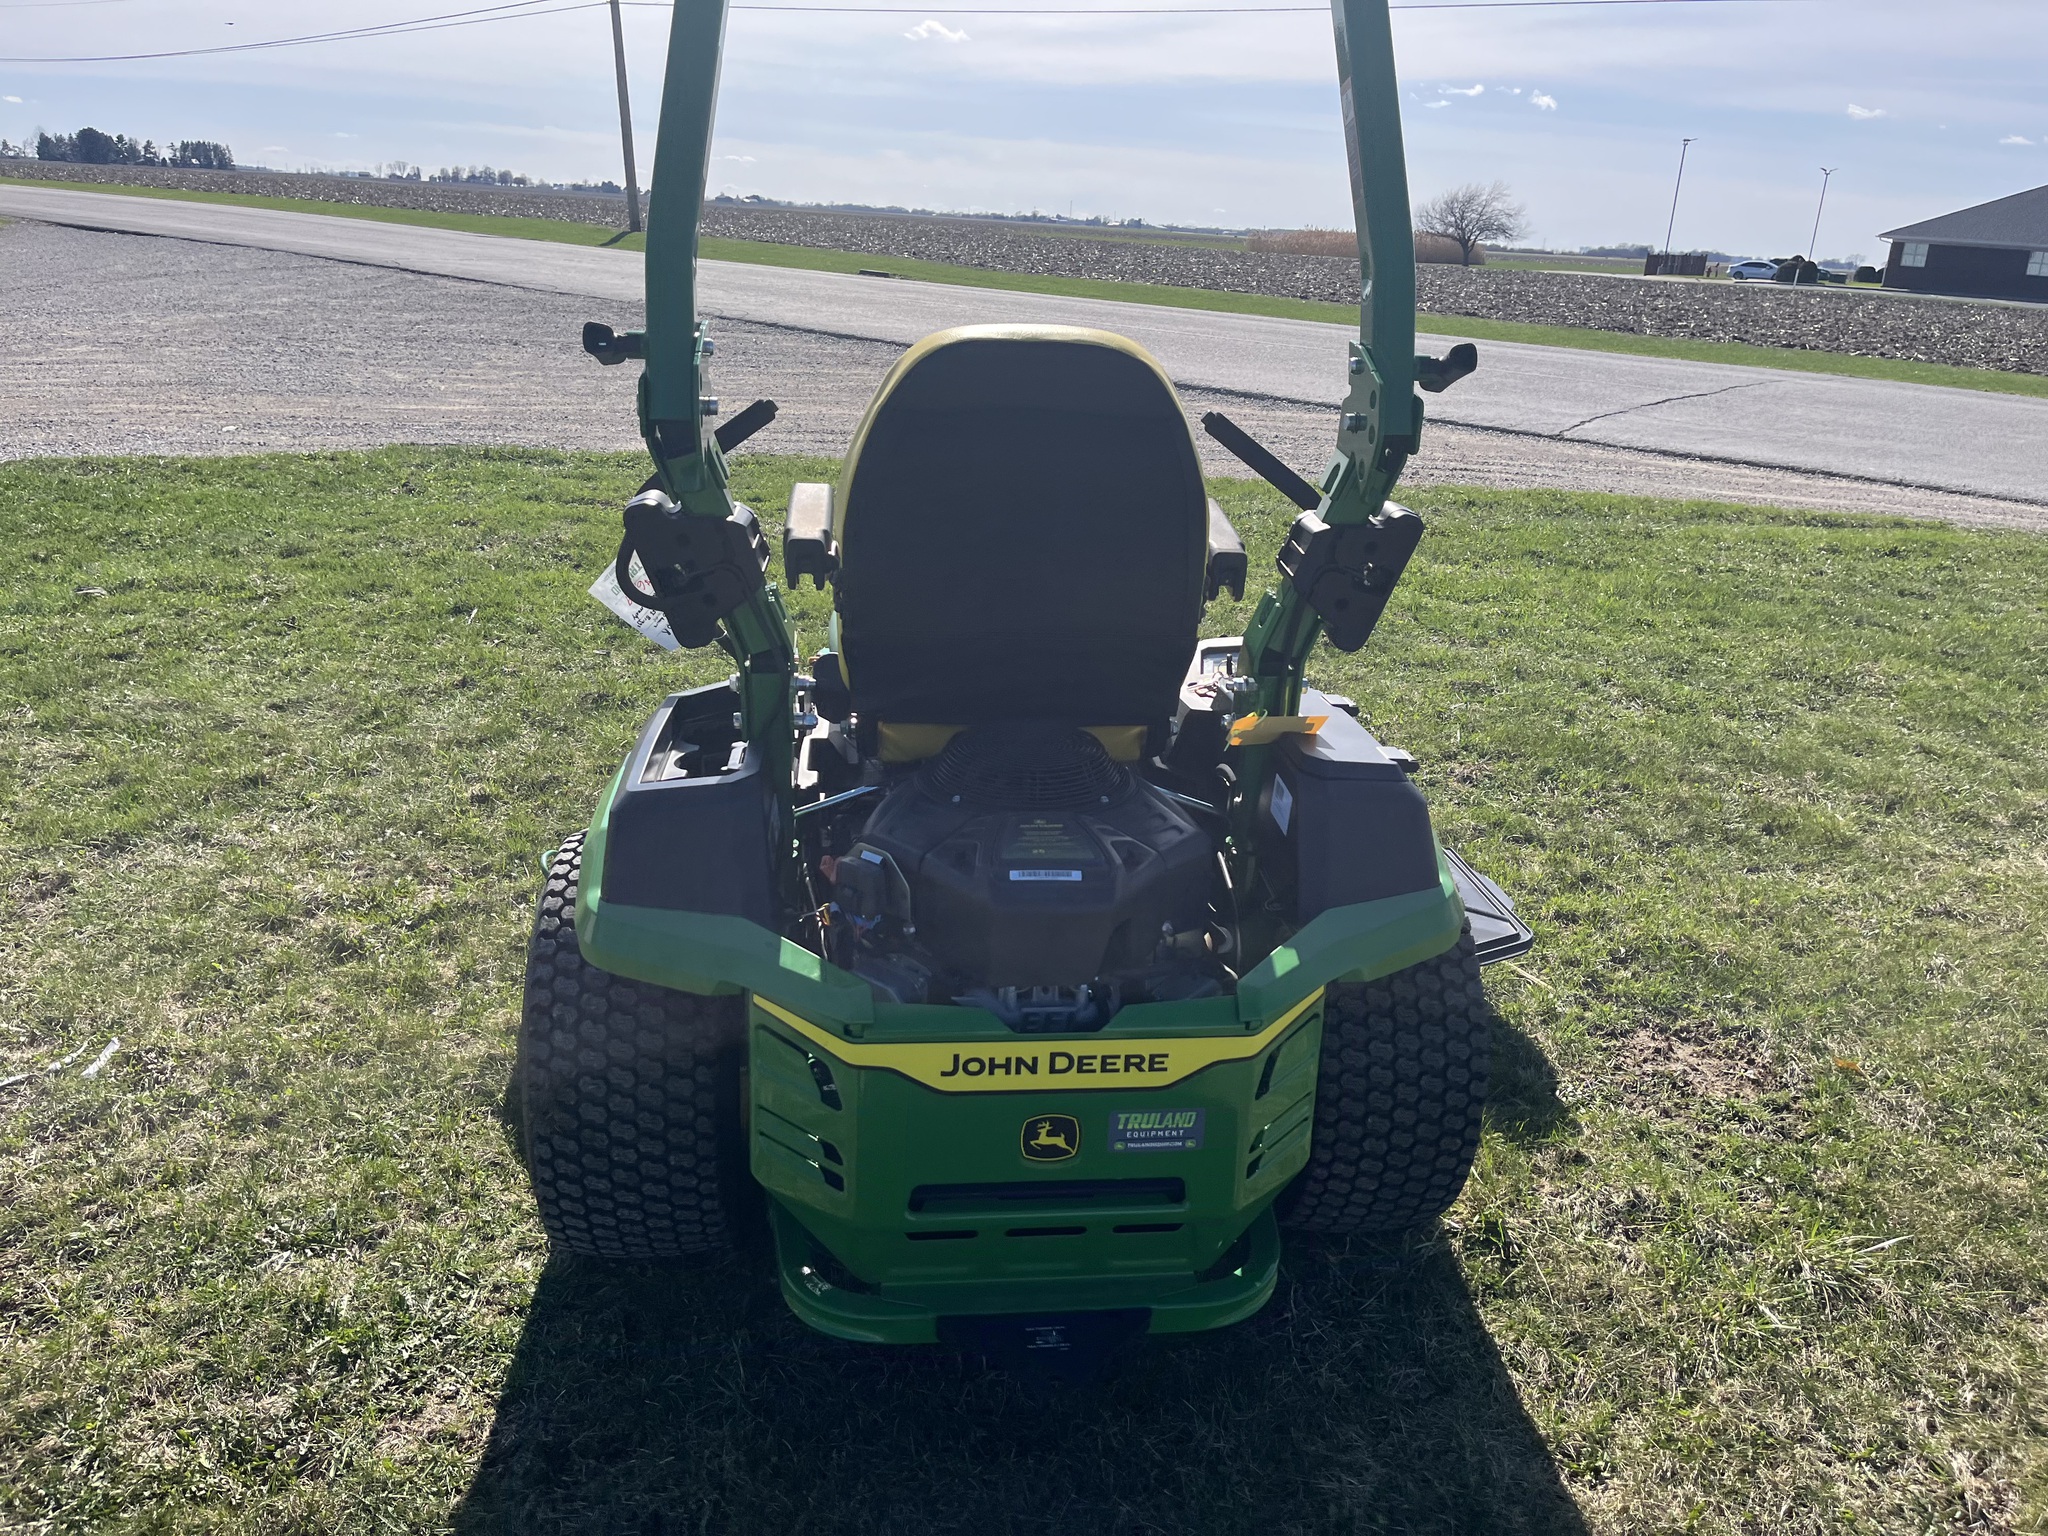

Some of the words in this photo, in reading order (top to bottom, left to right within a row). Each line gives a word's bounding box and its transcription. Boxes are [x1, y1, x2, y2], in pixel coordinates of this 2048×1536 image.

[940, 1053, 1039, 1077] JOHN
[1048, 1052, 1169, 1075] DEERE
[1117, 1111, 1197, 1130] TRULAND
[1126, 1129, 1184, 1138] EQUIPMENT
